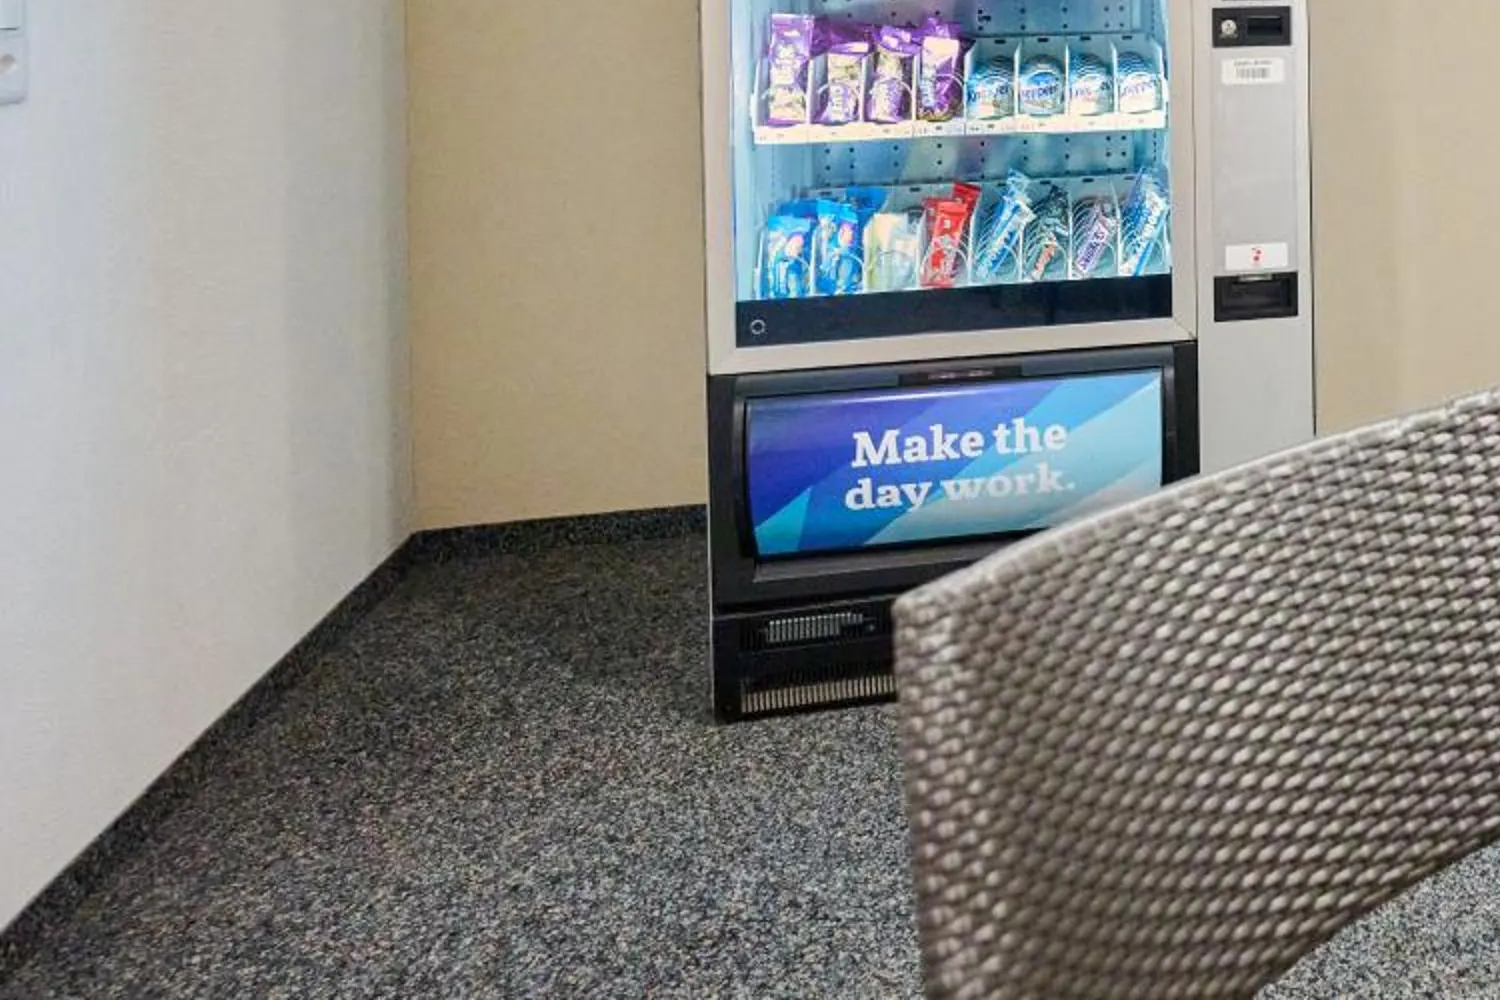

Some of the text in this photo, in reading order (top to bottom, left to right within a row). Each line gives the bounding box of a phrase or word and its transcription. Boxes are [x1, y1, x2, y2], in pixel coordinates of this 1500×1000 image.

[851, 416, 1069, 468] Make the
[844, 461, 1076, 512] day work.
